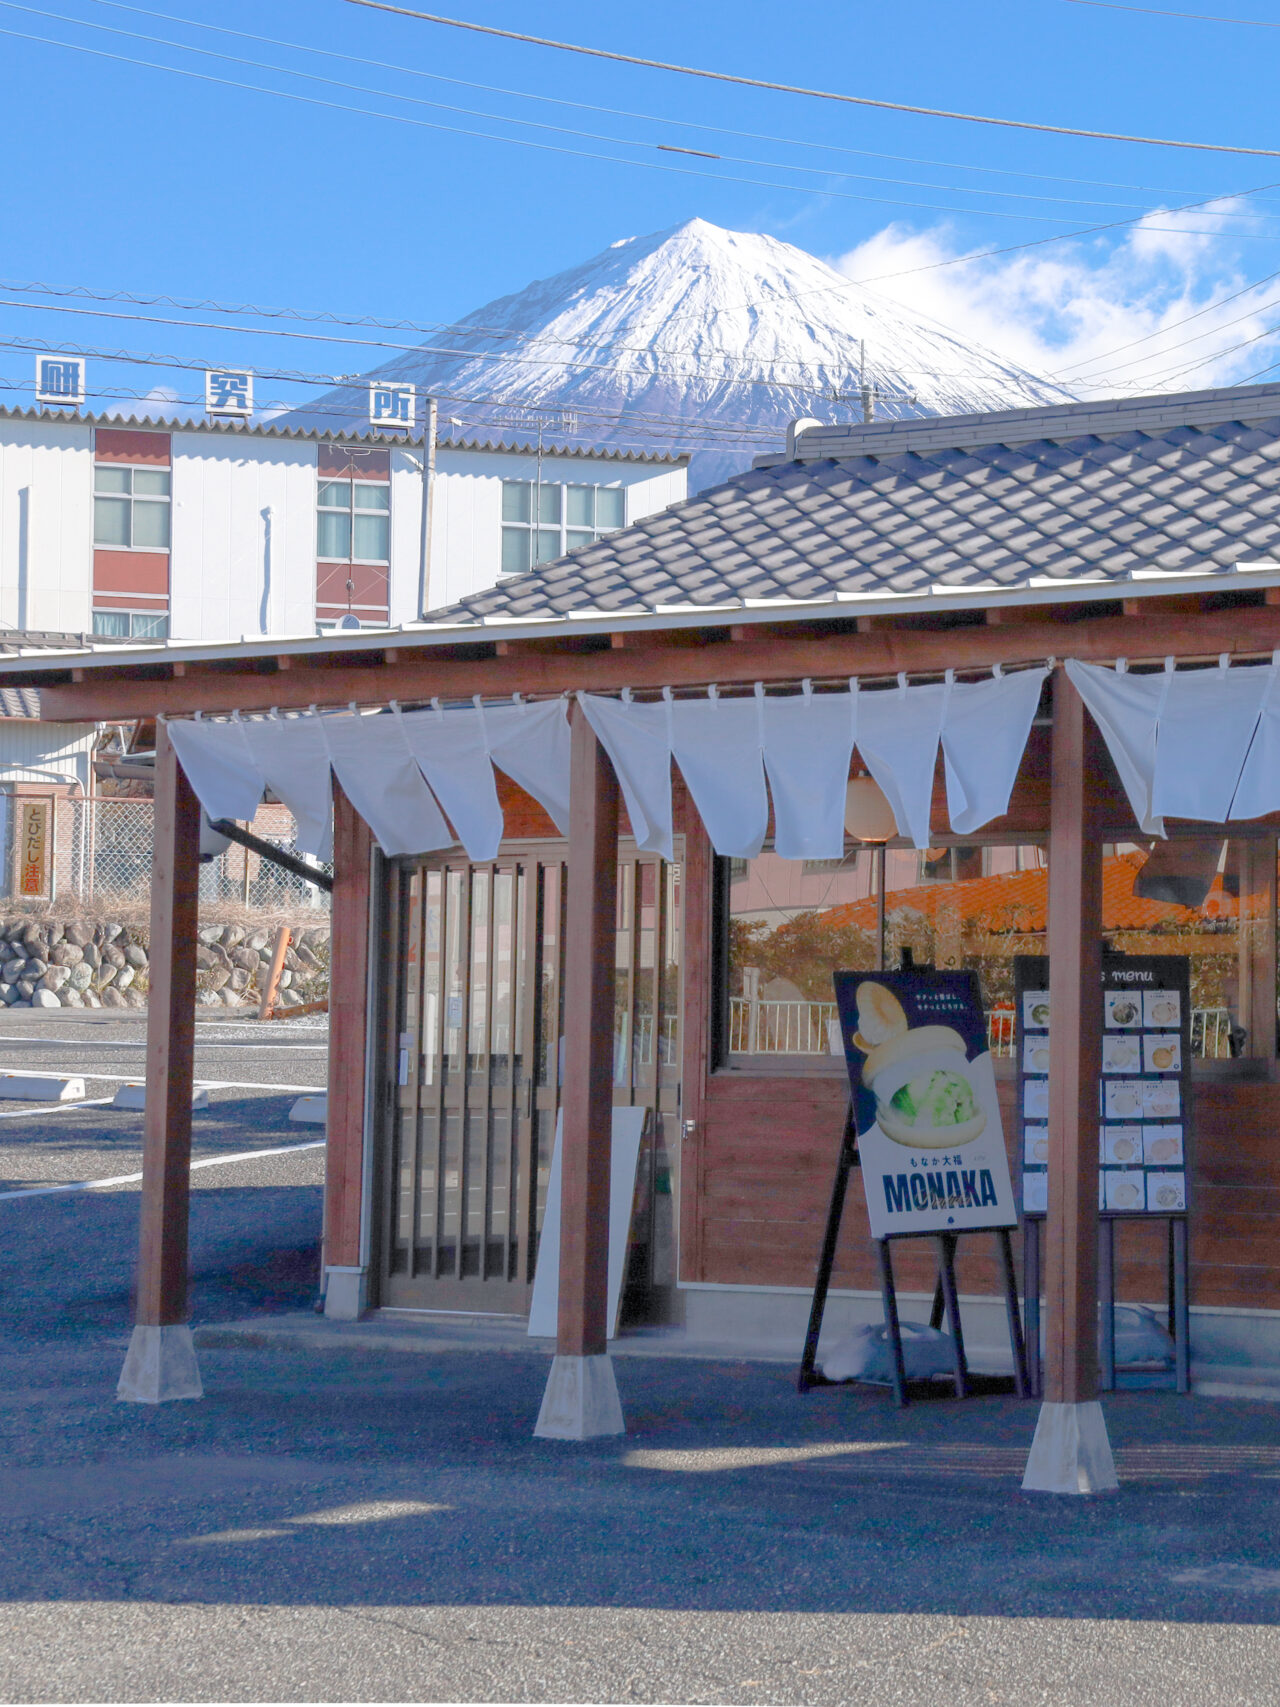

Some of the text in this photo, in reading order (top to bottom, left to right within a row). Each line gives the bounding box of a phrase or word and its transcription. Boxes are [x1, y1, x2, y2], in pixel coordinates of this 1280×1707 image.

[24, 808, 41, 892] とびだし注意
[1111, 970, 1153, 982] menu
[910, 1154, 963, 1168] もなか大福
[882, 1168, 998, 1213] MONAKA
